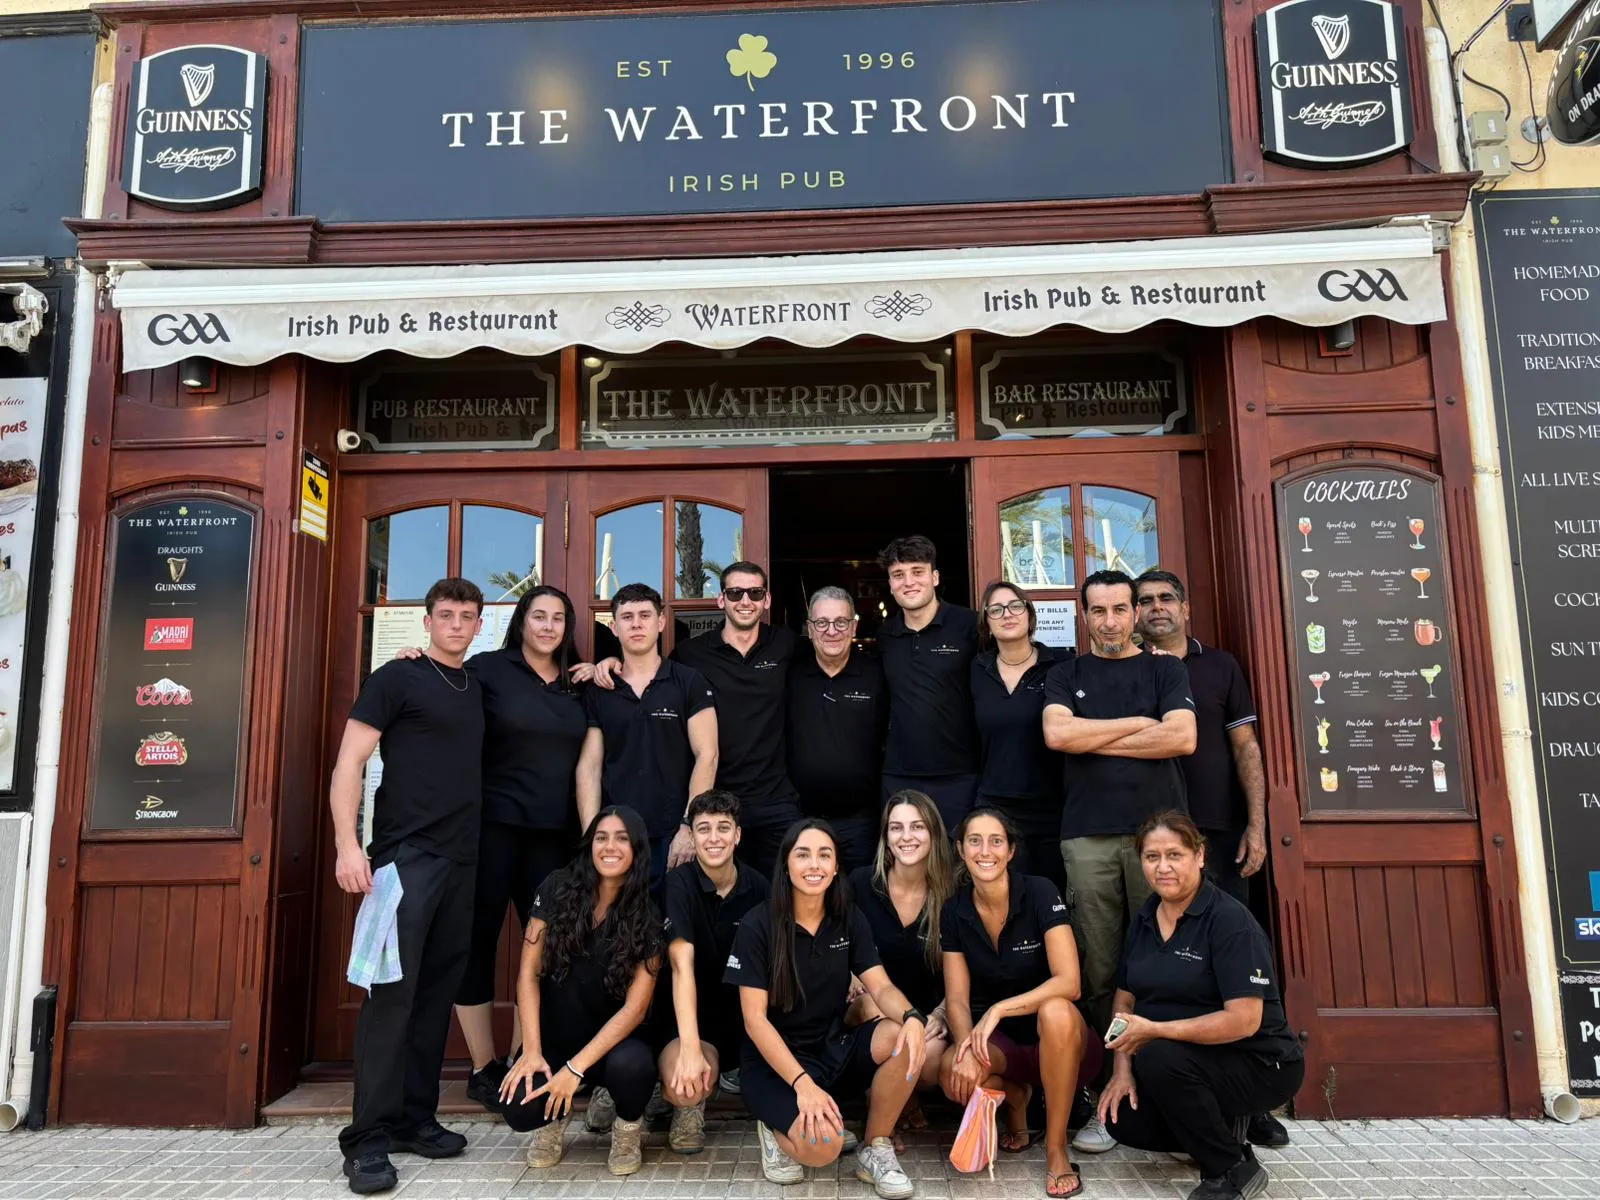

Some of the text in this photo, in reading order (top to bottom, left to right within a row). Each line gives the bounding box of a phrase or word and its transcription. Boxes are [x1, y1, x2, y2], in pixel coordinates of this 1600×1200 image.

[617, 52, 915, 78] EST 1996
[1271, 61, 1398, 89] GUINNESS
[1568, 82, 1600, 122] ON DRA
[136, 108, 252, 134] GUINNESS
[441, 92, 1075, 148] THE WATERFRONT
[669, 170, 846, 192] IRISH PUB
[1503, 228, 1526, 236] THE
[1514, 265, 1600, 280] HOMEMAD
[1318, 267, 1409, 303] GAA
[1540, 287, 1590, 301] FOOD
[984, 280, 1267, 313] Irish Pub & Restaurant
[288, 308, 558, 338] Irish Pub & Restaurant
[684, 302, 851, 331] WATERFRONT
[147, 312, 231, 346] GAA
[1517, 332, 1600, 347] TRADITION
[603, 381, 931, 421] THE WATERFRONT
[995, 380, 1173, 404] BAR RESTAURANT
[371, 397, 540, 419] PUB RESTAURANT
[0, 420, 28, 441] pas
[1538, 424, 1600, 440] KIDS ME
[1303, 478, 1412, 502] COCKTAILS
[1521, 472, 1551, 487] ALL
[1553, 472, 1590, 486] LIVE
[128, 517, 238, 527] THE WATERFRONT
[157, 546, 204, 555] DRAUGHTS
[155, 582, 196, 592] GUINNESS
[1551, 641, 1600, 657] SUN T
[136, 684, 193, 706] Coors
[1541, 691, 1580, 707] KIDS
[144, 752, 180, 761] ARTOIS
[146, 745, 179, 753] STELLA
[135, 809, 180, 820] STRONGBOW
